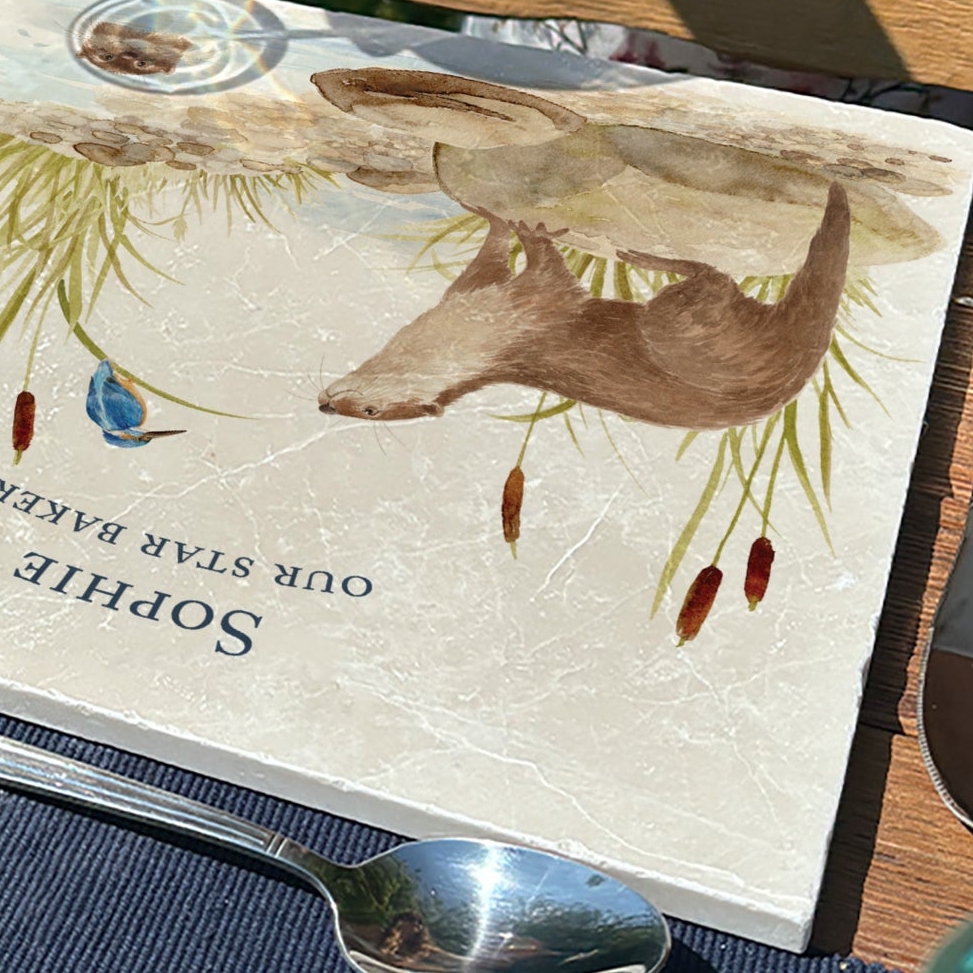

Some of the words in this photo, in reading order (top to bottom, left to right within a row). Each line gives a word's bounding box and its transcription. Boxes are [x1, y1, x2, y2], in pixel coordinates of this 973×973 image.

[140, 532, 256, 579] STAR
[13, 550, 263, 657] SOPHIE
[273, 563, 374, 598] OUR
